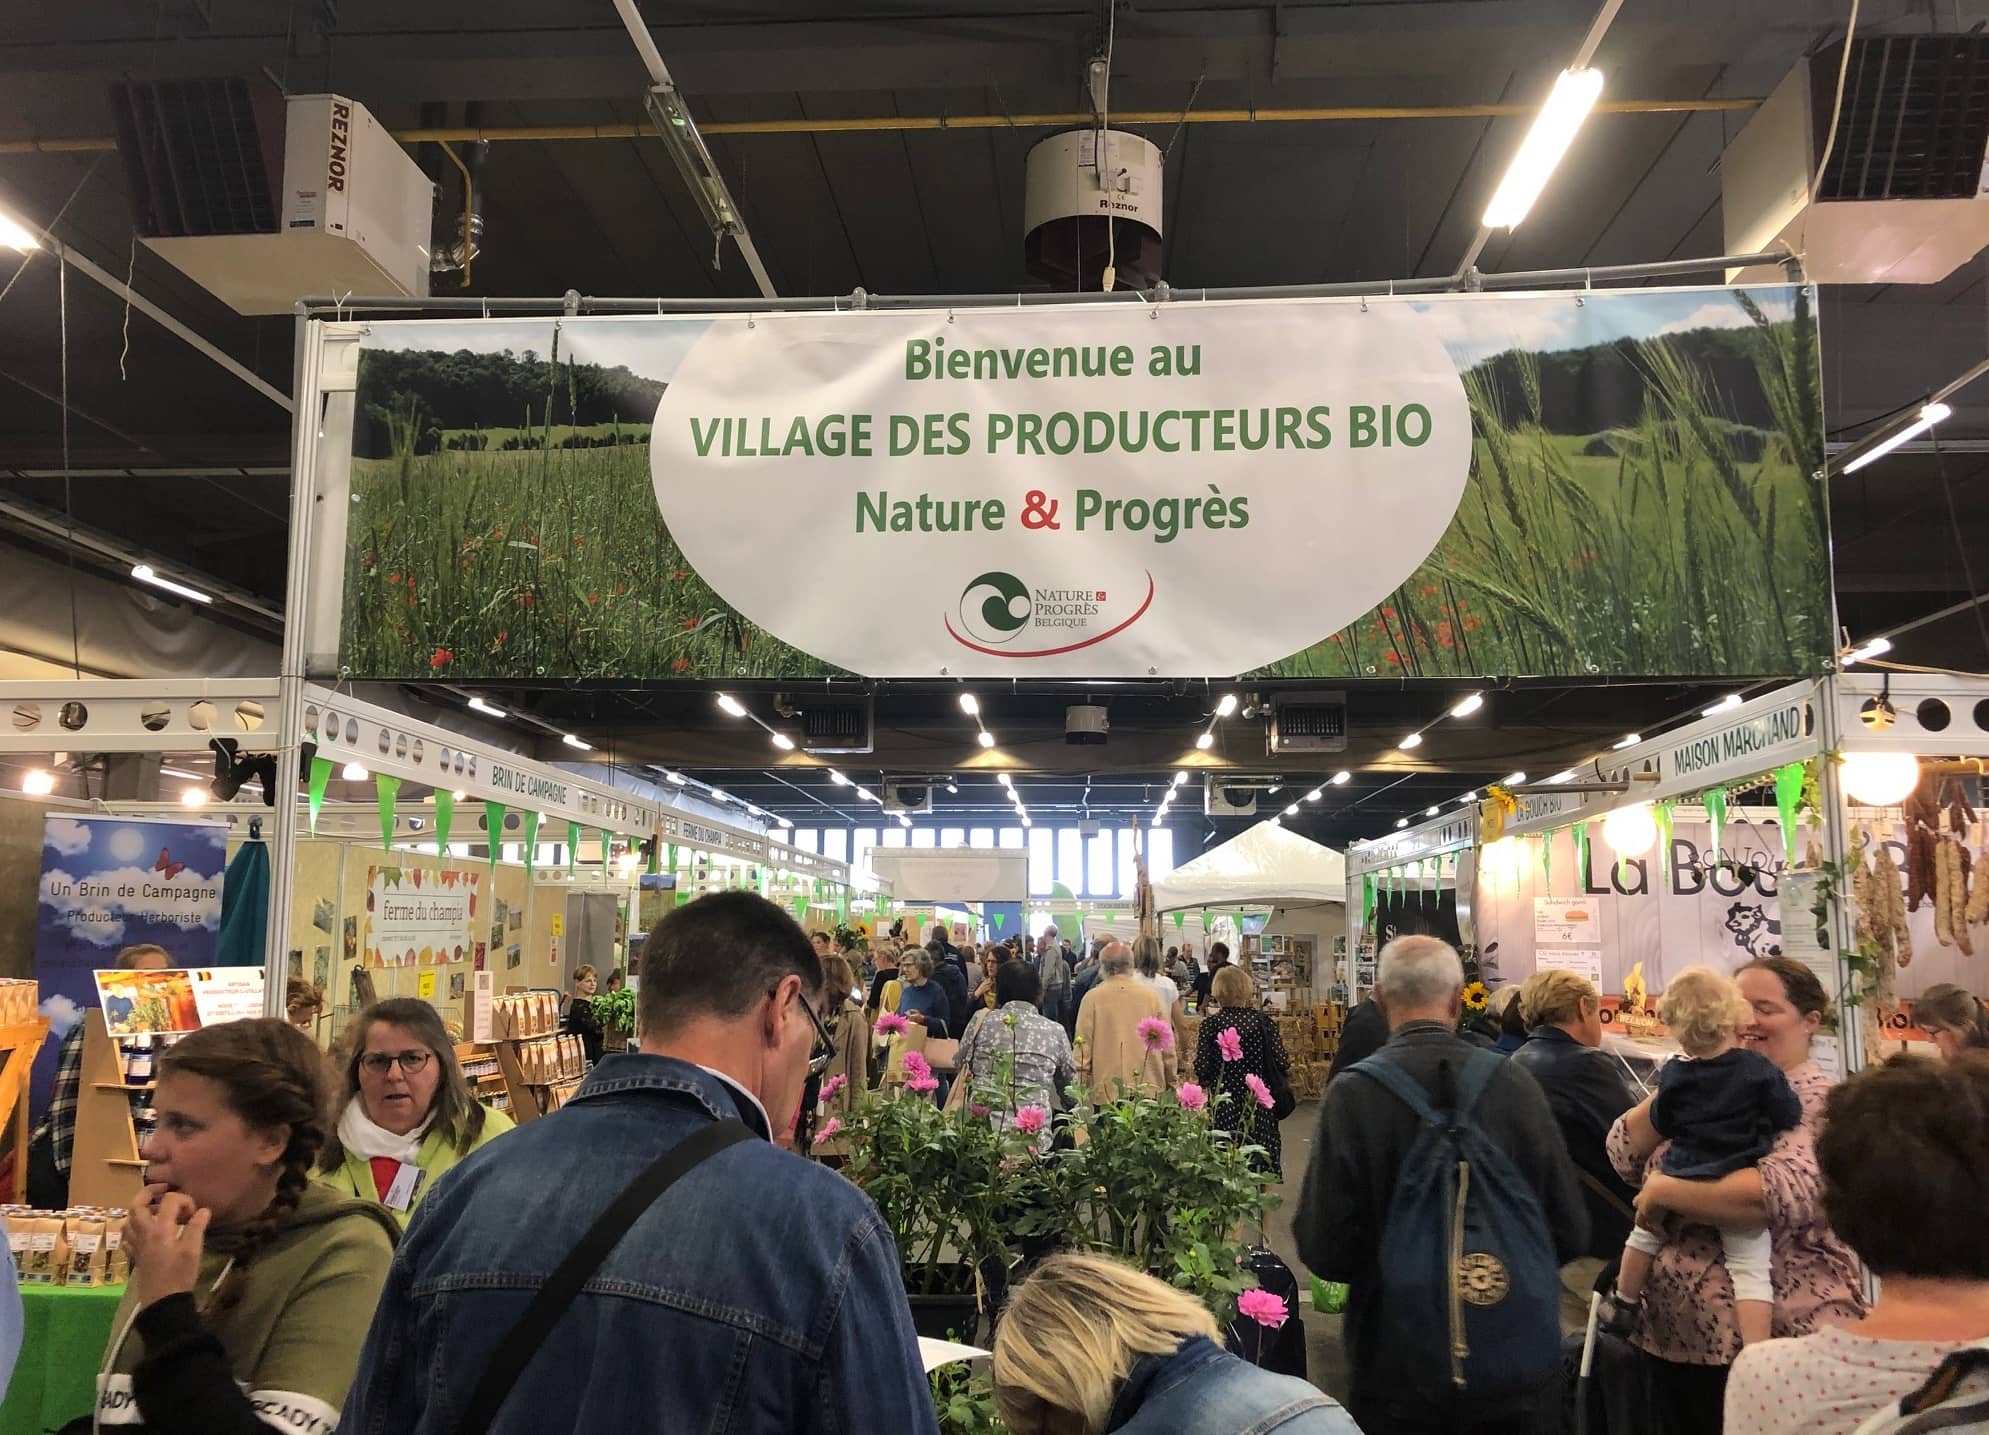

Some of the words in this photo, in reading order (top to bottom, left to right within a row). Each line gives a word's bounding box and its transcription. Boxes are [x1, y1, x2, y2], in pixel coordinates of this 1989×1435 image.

[328, 102, 350, 192] REZNOR
[905, 336, 1135, 381] Bienvenue
[1148, 344, 1201, 376] au
[690, 413, 873, 457] VILLAGE
[889, 412, 971, 456] DES
[987, 405, 1332, 455] PRODUCTEURS
[1349, 403, 1432, 448] BIO
[855, 491, 1006, 533] Nature
[1020, 490, 1061, 531] &
[1076, 483, 1249, 543] Progrès
[1035, 589, 1094, 602] NATURE
[1035, 602, 1099, 616] PROGRÈS
[1035, 617, 1087, 628] BELGIQUE
[1674, 735, 1720, 777] MAISON
[1723, 705, 1800, 758] MARCHAND
[492, 765, 513, 790] BRIN
[515, 772, 526, 793] DE
[528, 776, 567, 805] CAMPAGNE
[1585, 838, 1649, 895] La
[50, 882, 71, 897] Un
[79, 882, 110, 898] Brin
[117, 883, 135, 898] de
[142, 883, 216, 903] Campagne
[383, 900, 414, 921] ferme
[415, 901, 428, 921] du
[100, 1390, 136, 1409] ADY
